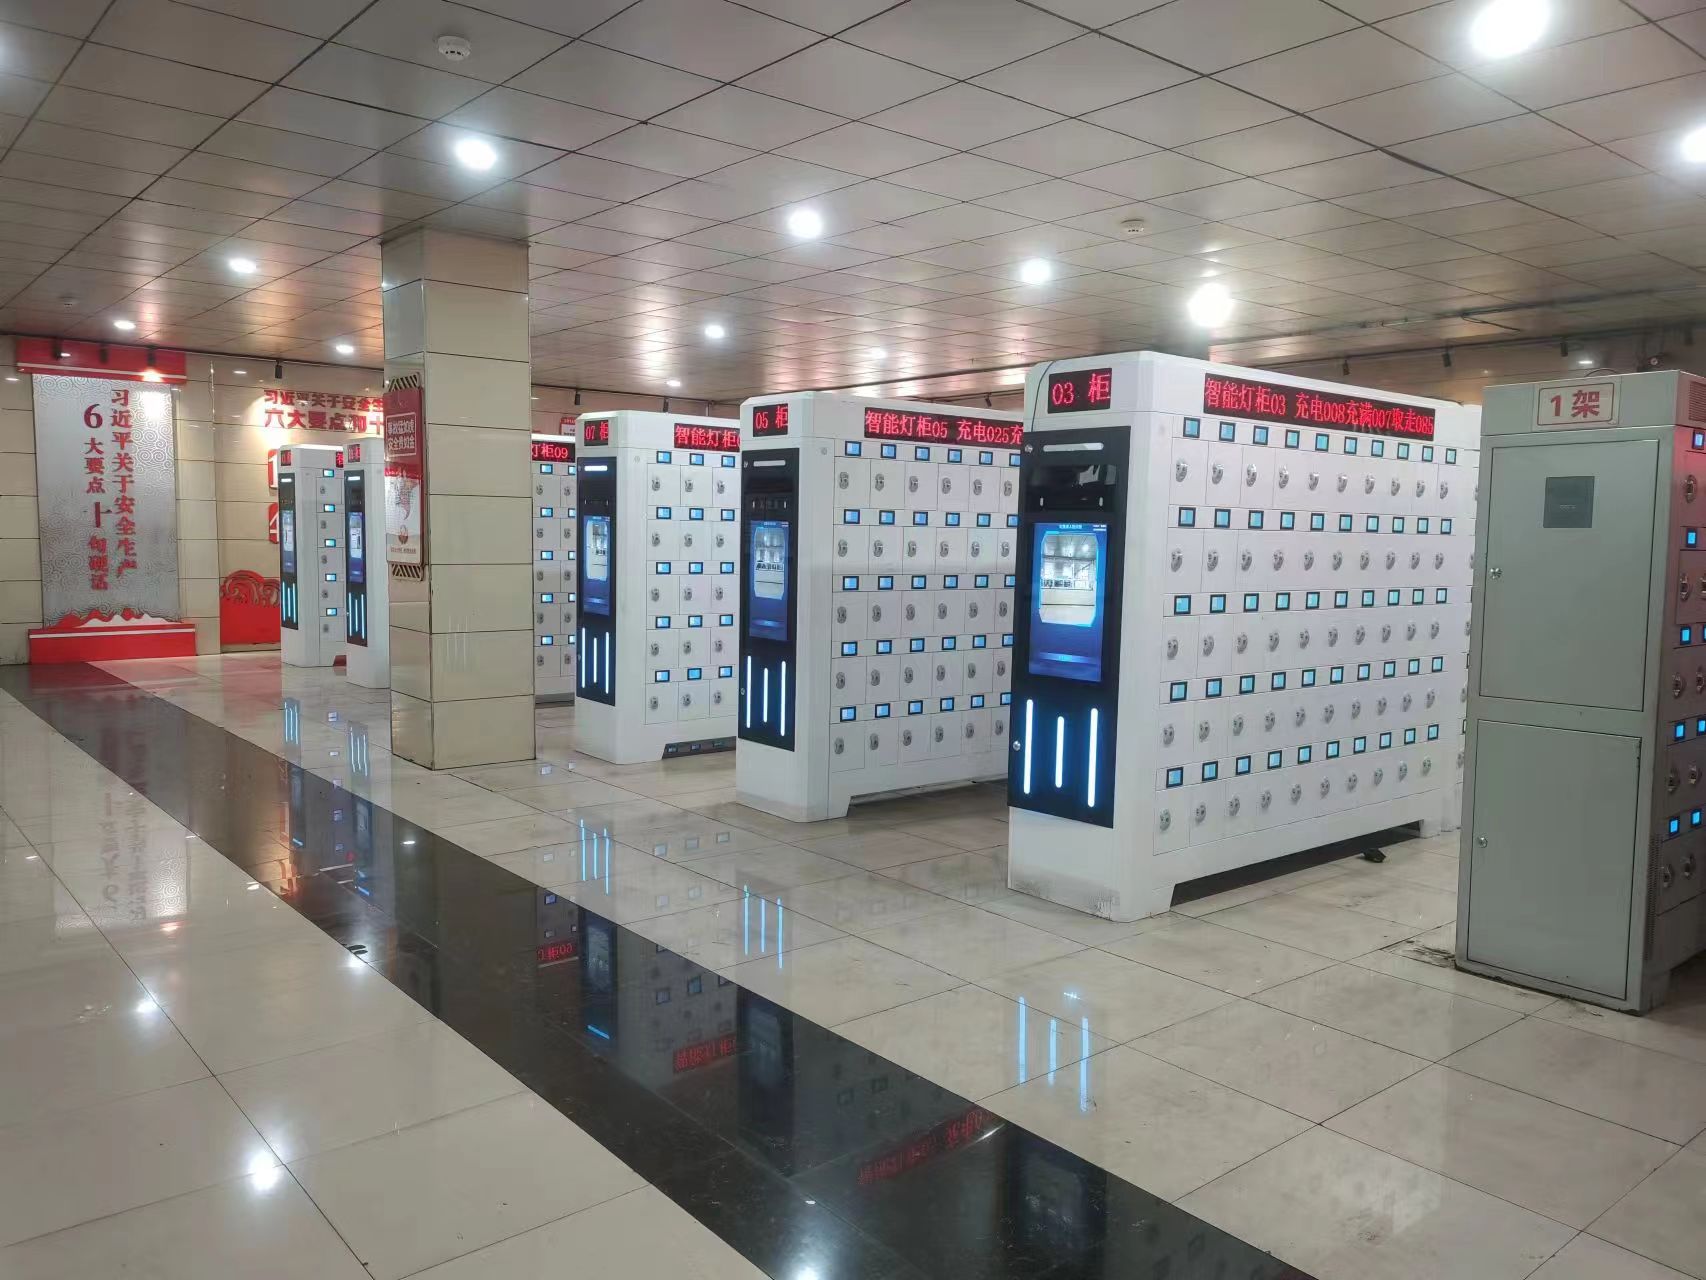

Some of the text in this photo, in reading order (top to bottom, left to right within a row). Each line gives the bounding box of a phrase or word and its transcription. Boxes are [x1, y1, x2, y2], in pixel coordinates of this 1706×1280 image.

[1052, 373, 1111, 405] 03 柜
[1205, 377, 1287, 416] 智能灯柜03
[1550, 389, 1600, 418] 1 架
[585, 425, 596, 440] 07
[755, 405, 788, 430] 05 柜
[865, 410, 1024, 445] 智能灯柜05 充电025充
[109, 389, 138, 578] 习近平关于安全生产
